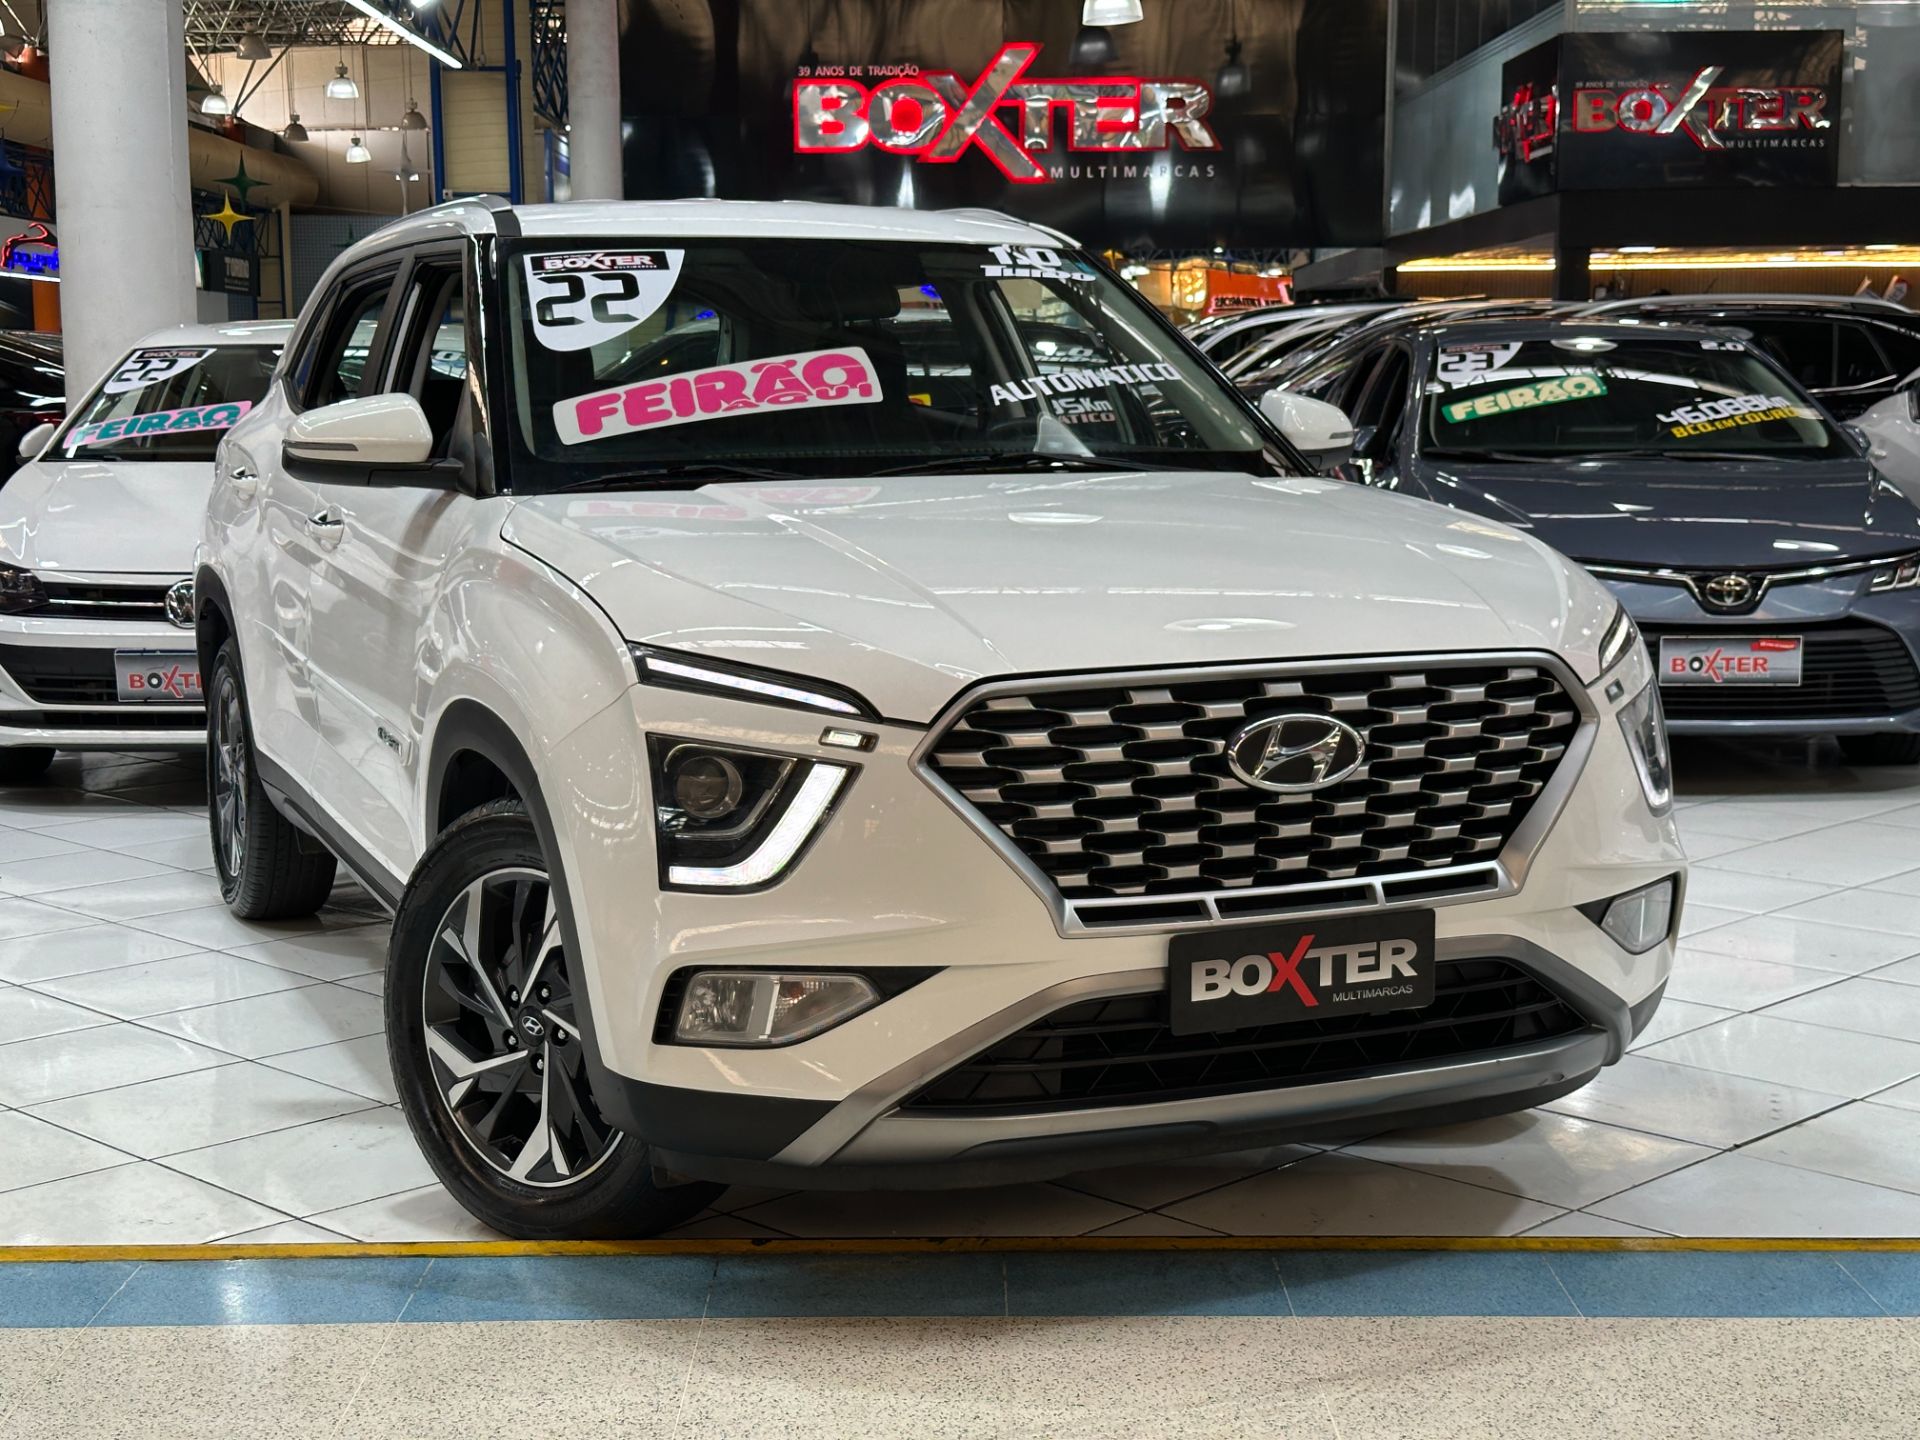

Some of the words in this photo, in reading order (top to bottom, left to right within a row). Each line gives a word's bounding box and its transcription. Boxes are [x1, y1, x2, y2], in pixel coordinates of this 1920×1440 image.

[797, 66, 811, 77] 39
[815, 66, 845, 76] ANOS
[849, 66, 863, 76] DE
[868, 63, 919, 78] TRADIÇÃO
[794, 42, 1222, 184] BOXTER
[1572, 65, 1831, 150] BOXTER
[1726, 138, 1826, 149] MULTIMARCAS
[1050, 164, 1216, 179] MULTIMARCAS
[542, 252, 654, 270] BOXTER
[535, 271, 641, 328] 22
[1699, 340, 1745, 352] 2.0
[111, 358, 180, 383] 22
[1440, 351, 1495, 373] 23
[575, 353, 868, 436] FEIRÃO
[1451, 376, 1597, 421] FEIRÃO
[72, 404, 241, 445] FEIRÃO
[1669, 647, 1769, 683] BOXTER
[1191, 934, 1418, 1008] BOXTER
[1332, 984, 1414, 1002] MULTIMARCAS
